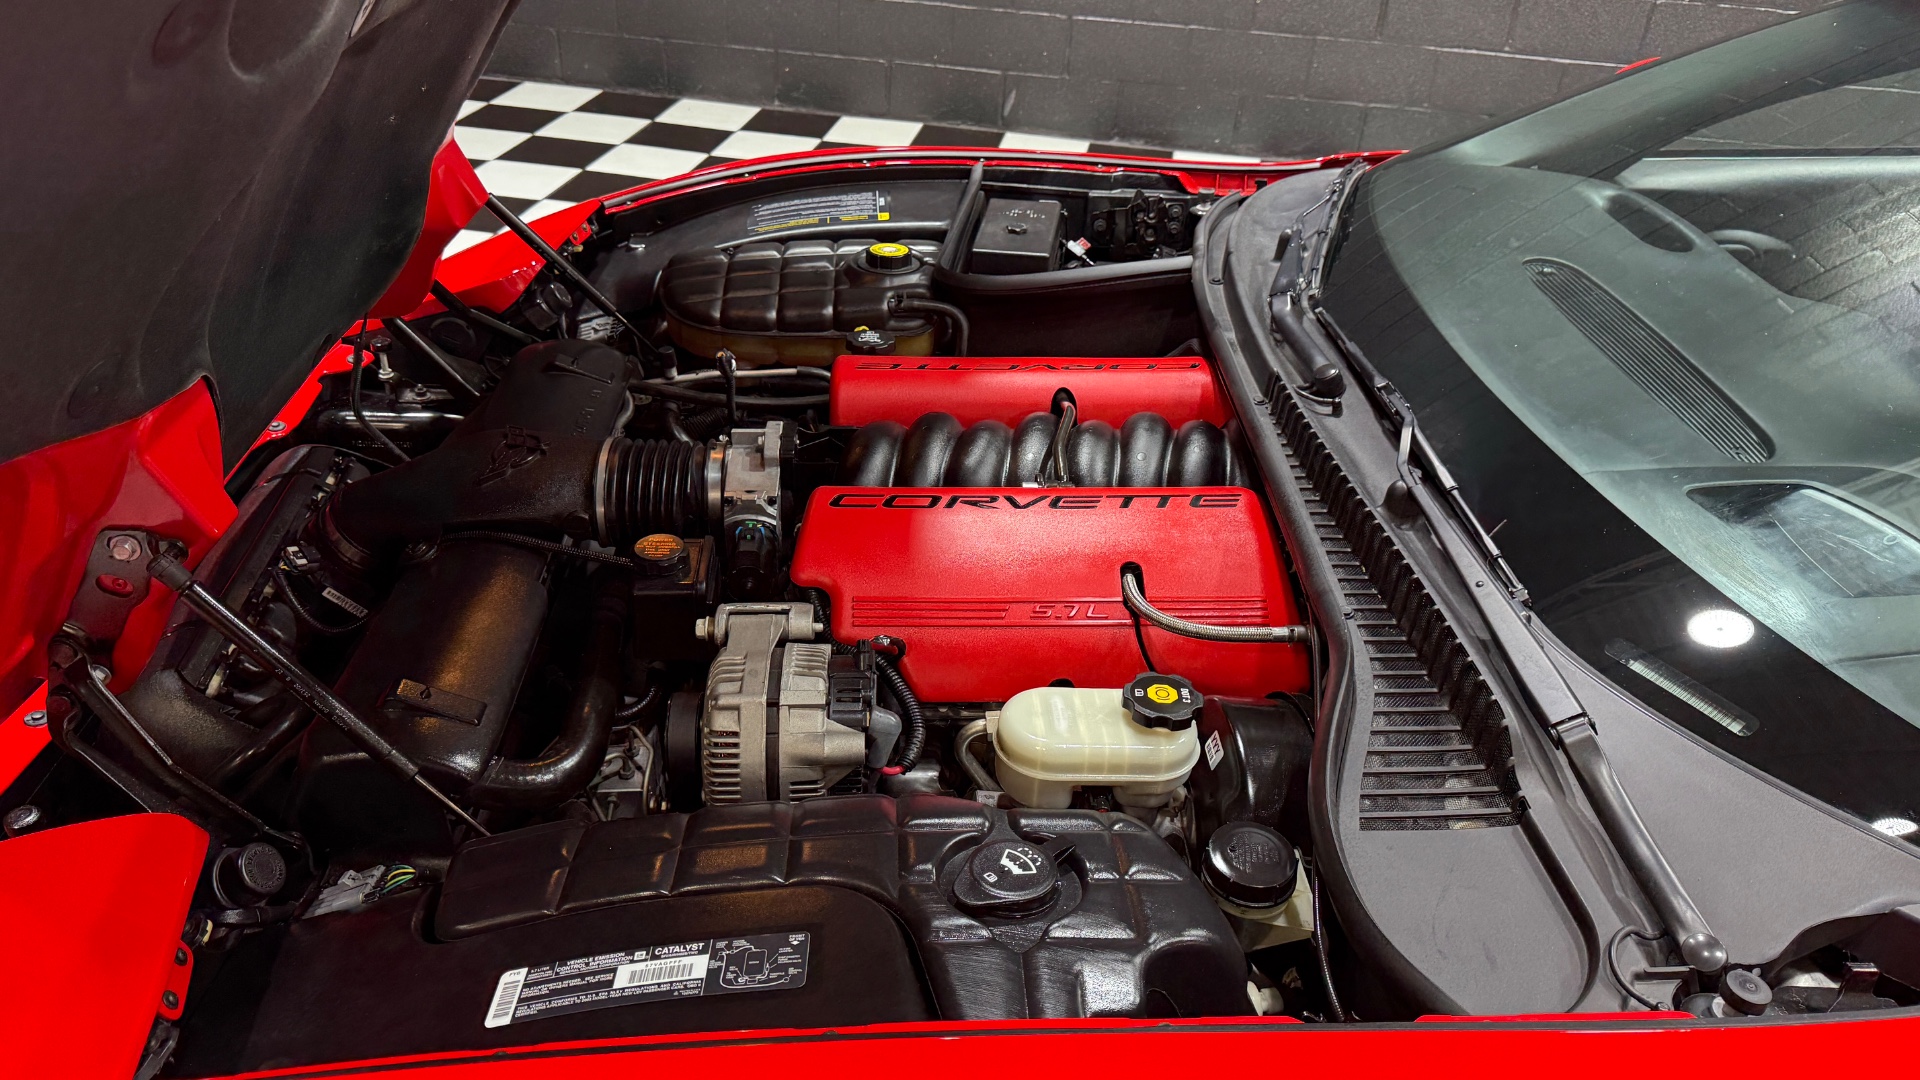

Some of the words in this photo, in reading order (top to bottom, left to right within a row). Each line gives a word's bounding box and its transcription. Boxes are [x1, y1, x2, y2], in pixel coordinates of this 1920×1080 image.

[854, 362, 1201, 370] CORVETTE
[829, 493, 1242, 509] CORVETTE
[1030, 604, 1108, 618] 5.7L
[654, 942, 705, 956] CATALYST
[594, 952, 626, 961] EMISSION
[556, 963, 586, 972] CONTROL
[589, 956, 633, 967] INFORMATION
